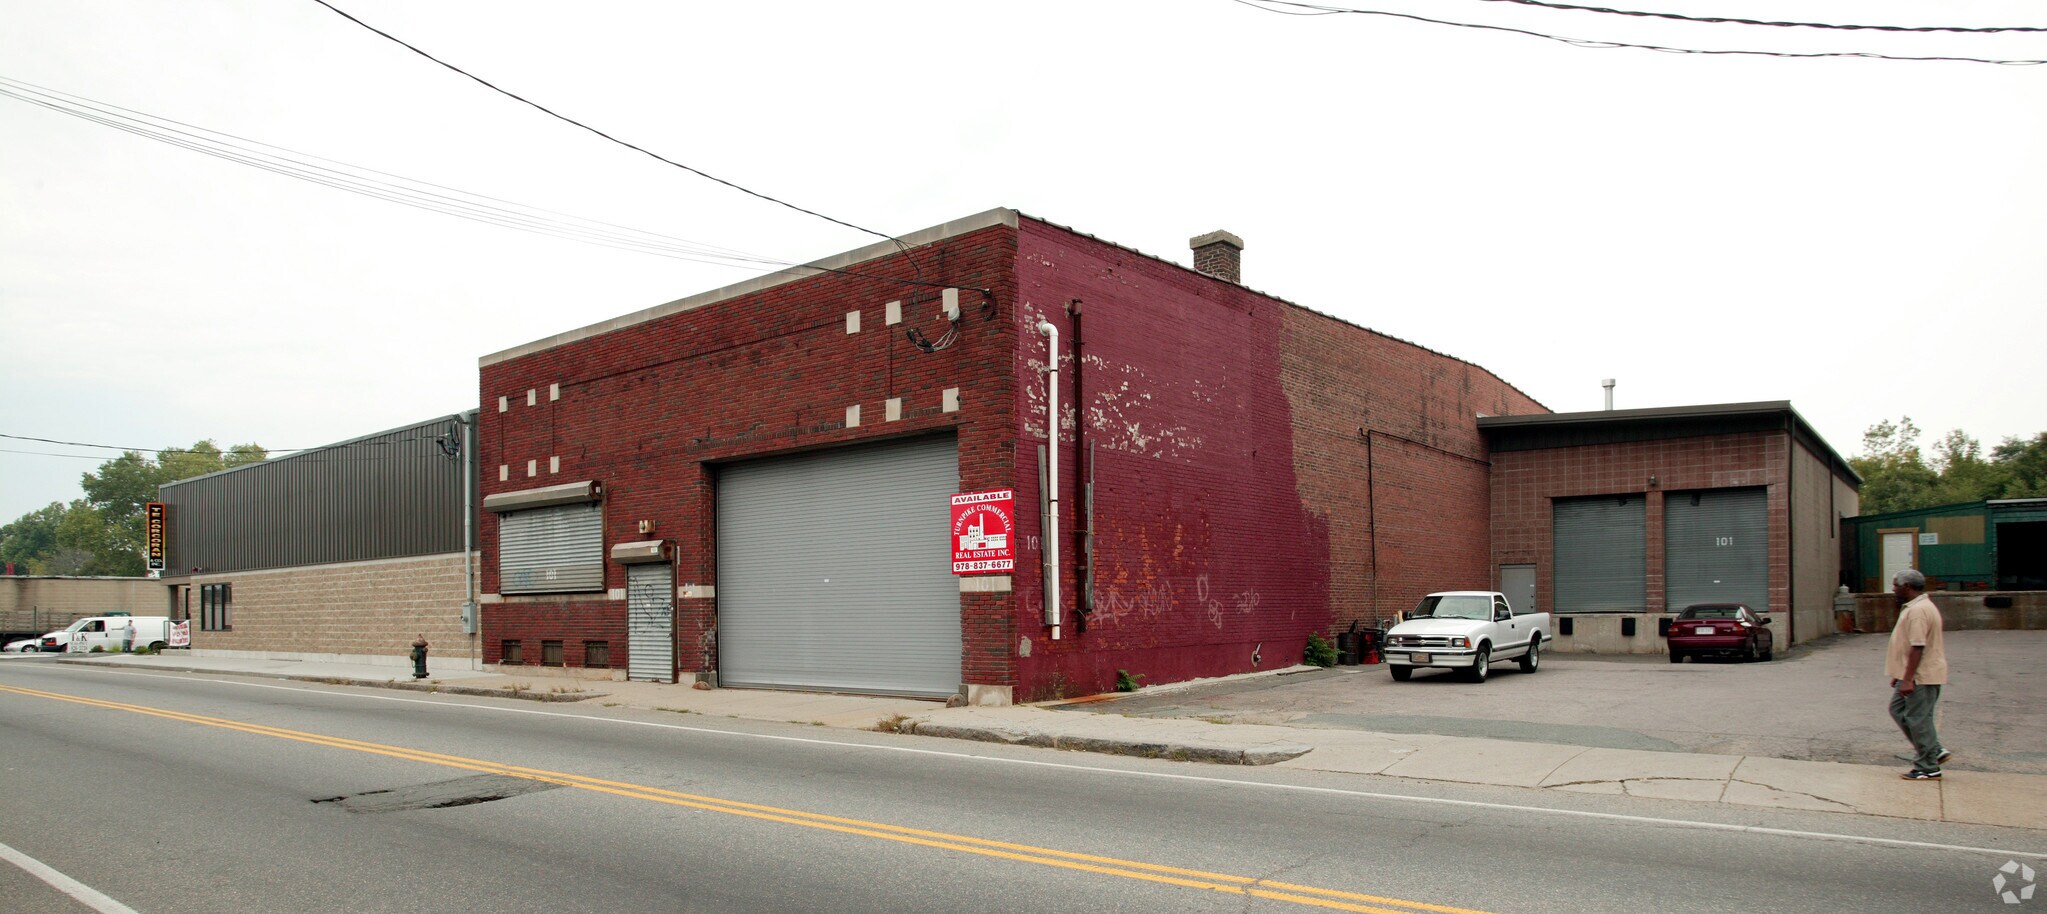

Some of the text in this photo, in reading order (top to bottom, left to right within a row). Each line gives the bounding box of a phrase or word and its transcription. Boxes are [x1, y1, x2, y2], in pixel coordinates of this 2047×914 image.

[954, 492, 1009, 503] AVAILABLE
[954, 504, 1012, 536] TURNPIKE COMMERCIAL
[1716, 537, 1733, 546] 101
[955, 561, 1010, 570] 978-837-6677
